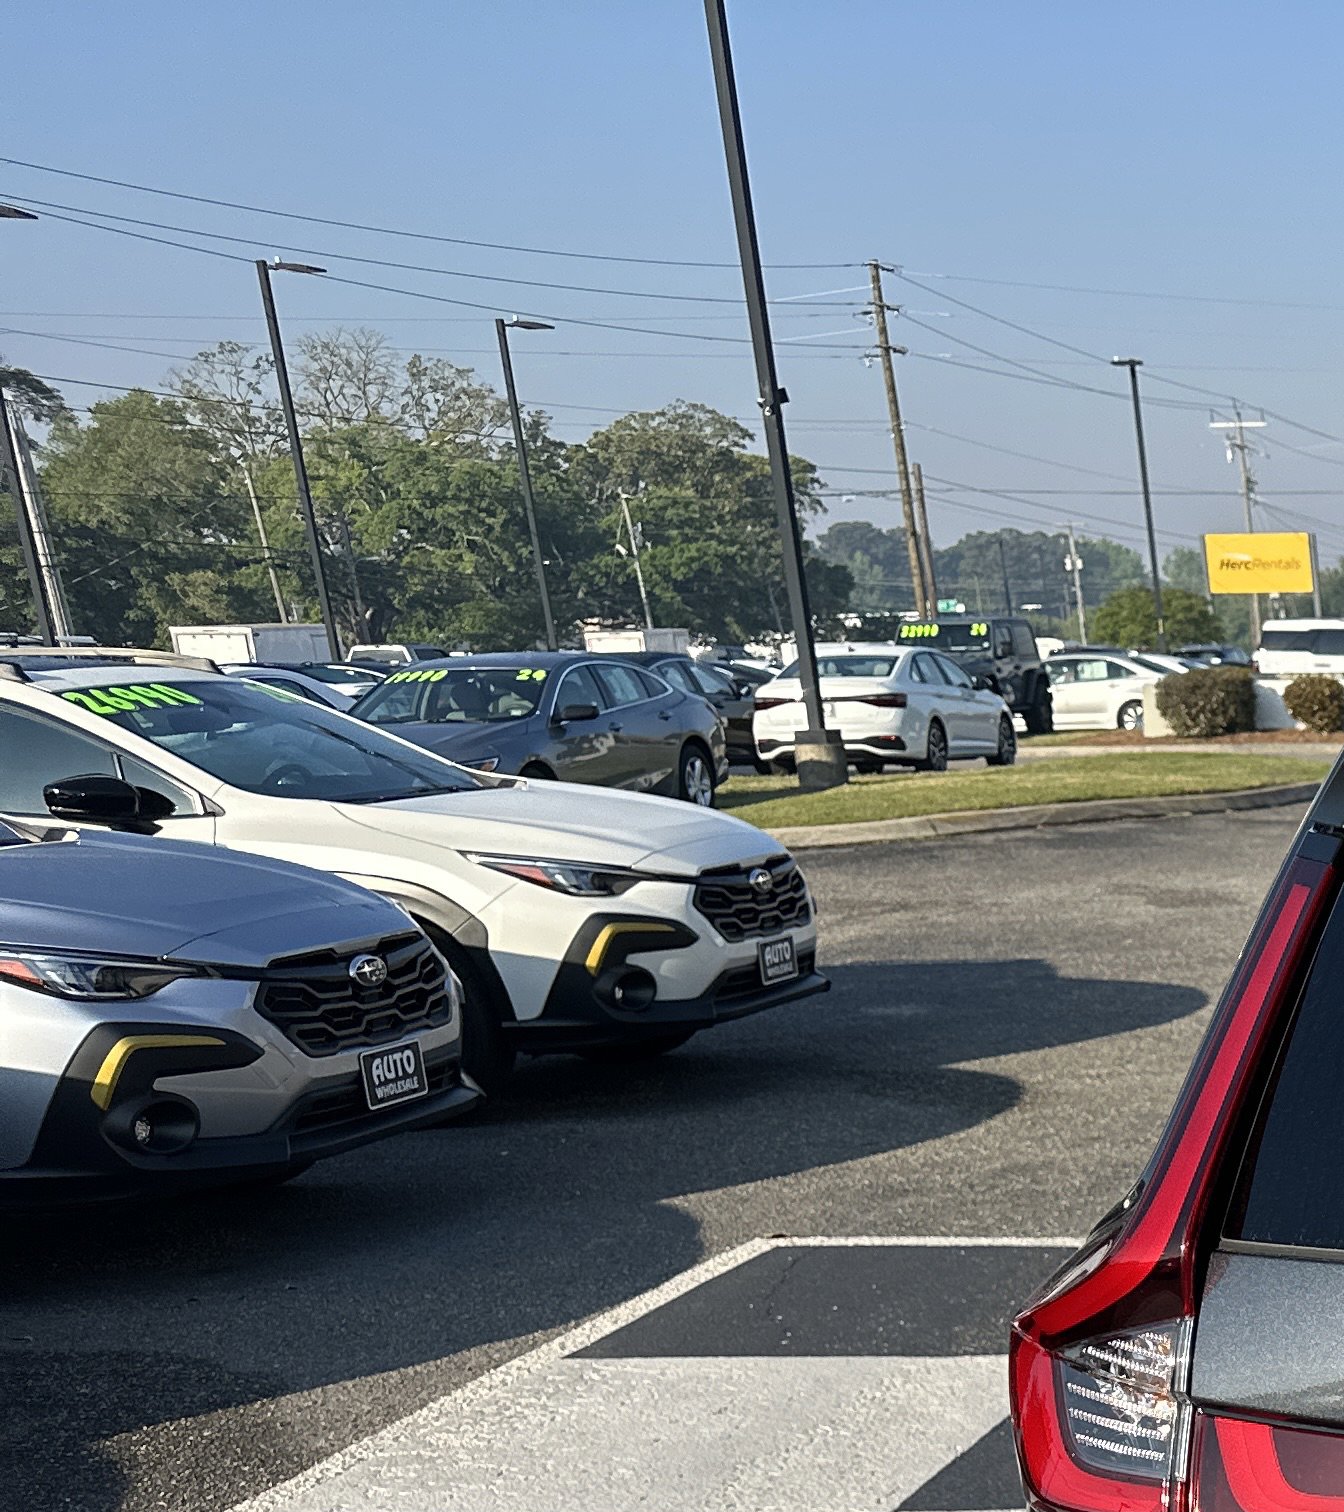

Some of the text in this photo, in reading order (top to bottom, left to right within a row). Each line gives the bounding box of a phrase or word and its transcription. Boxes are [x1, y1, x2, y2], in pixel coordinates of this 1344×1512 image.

[61, 683, 204, 715] 26990
[764, 941, 791, 967] AUTO
[372, 1049, 415, 1085] AUTO
[375, 1076, 419, 1099] WHOLESALE
